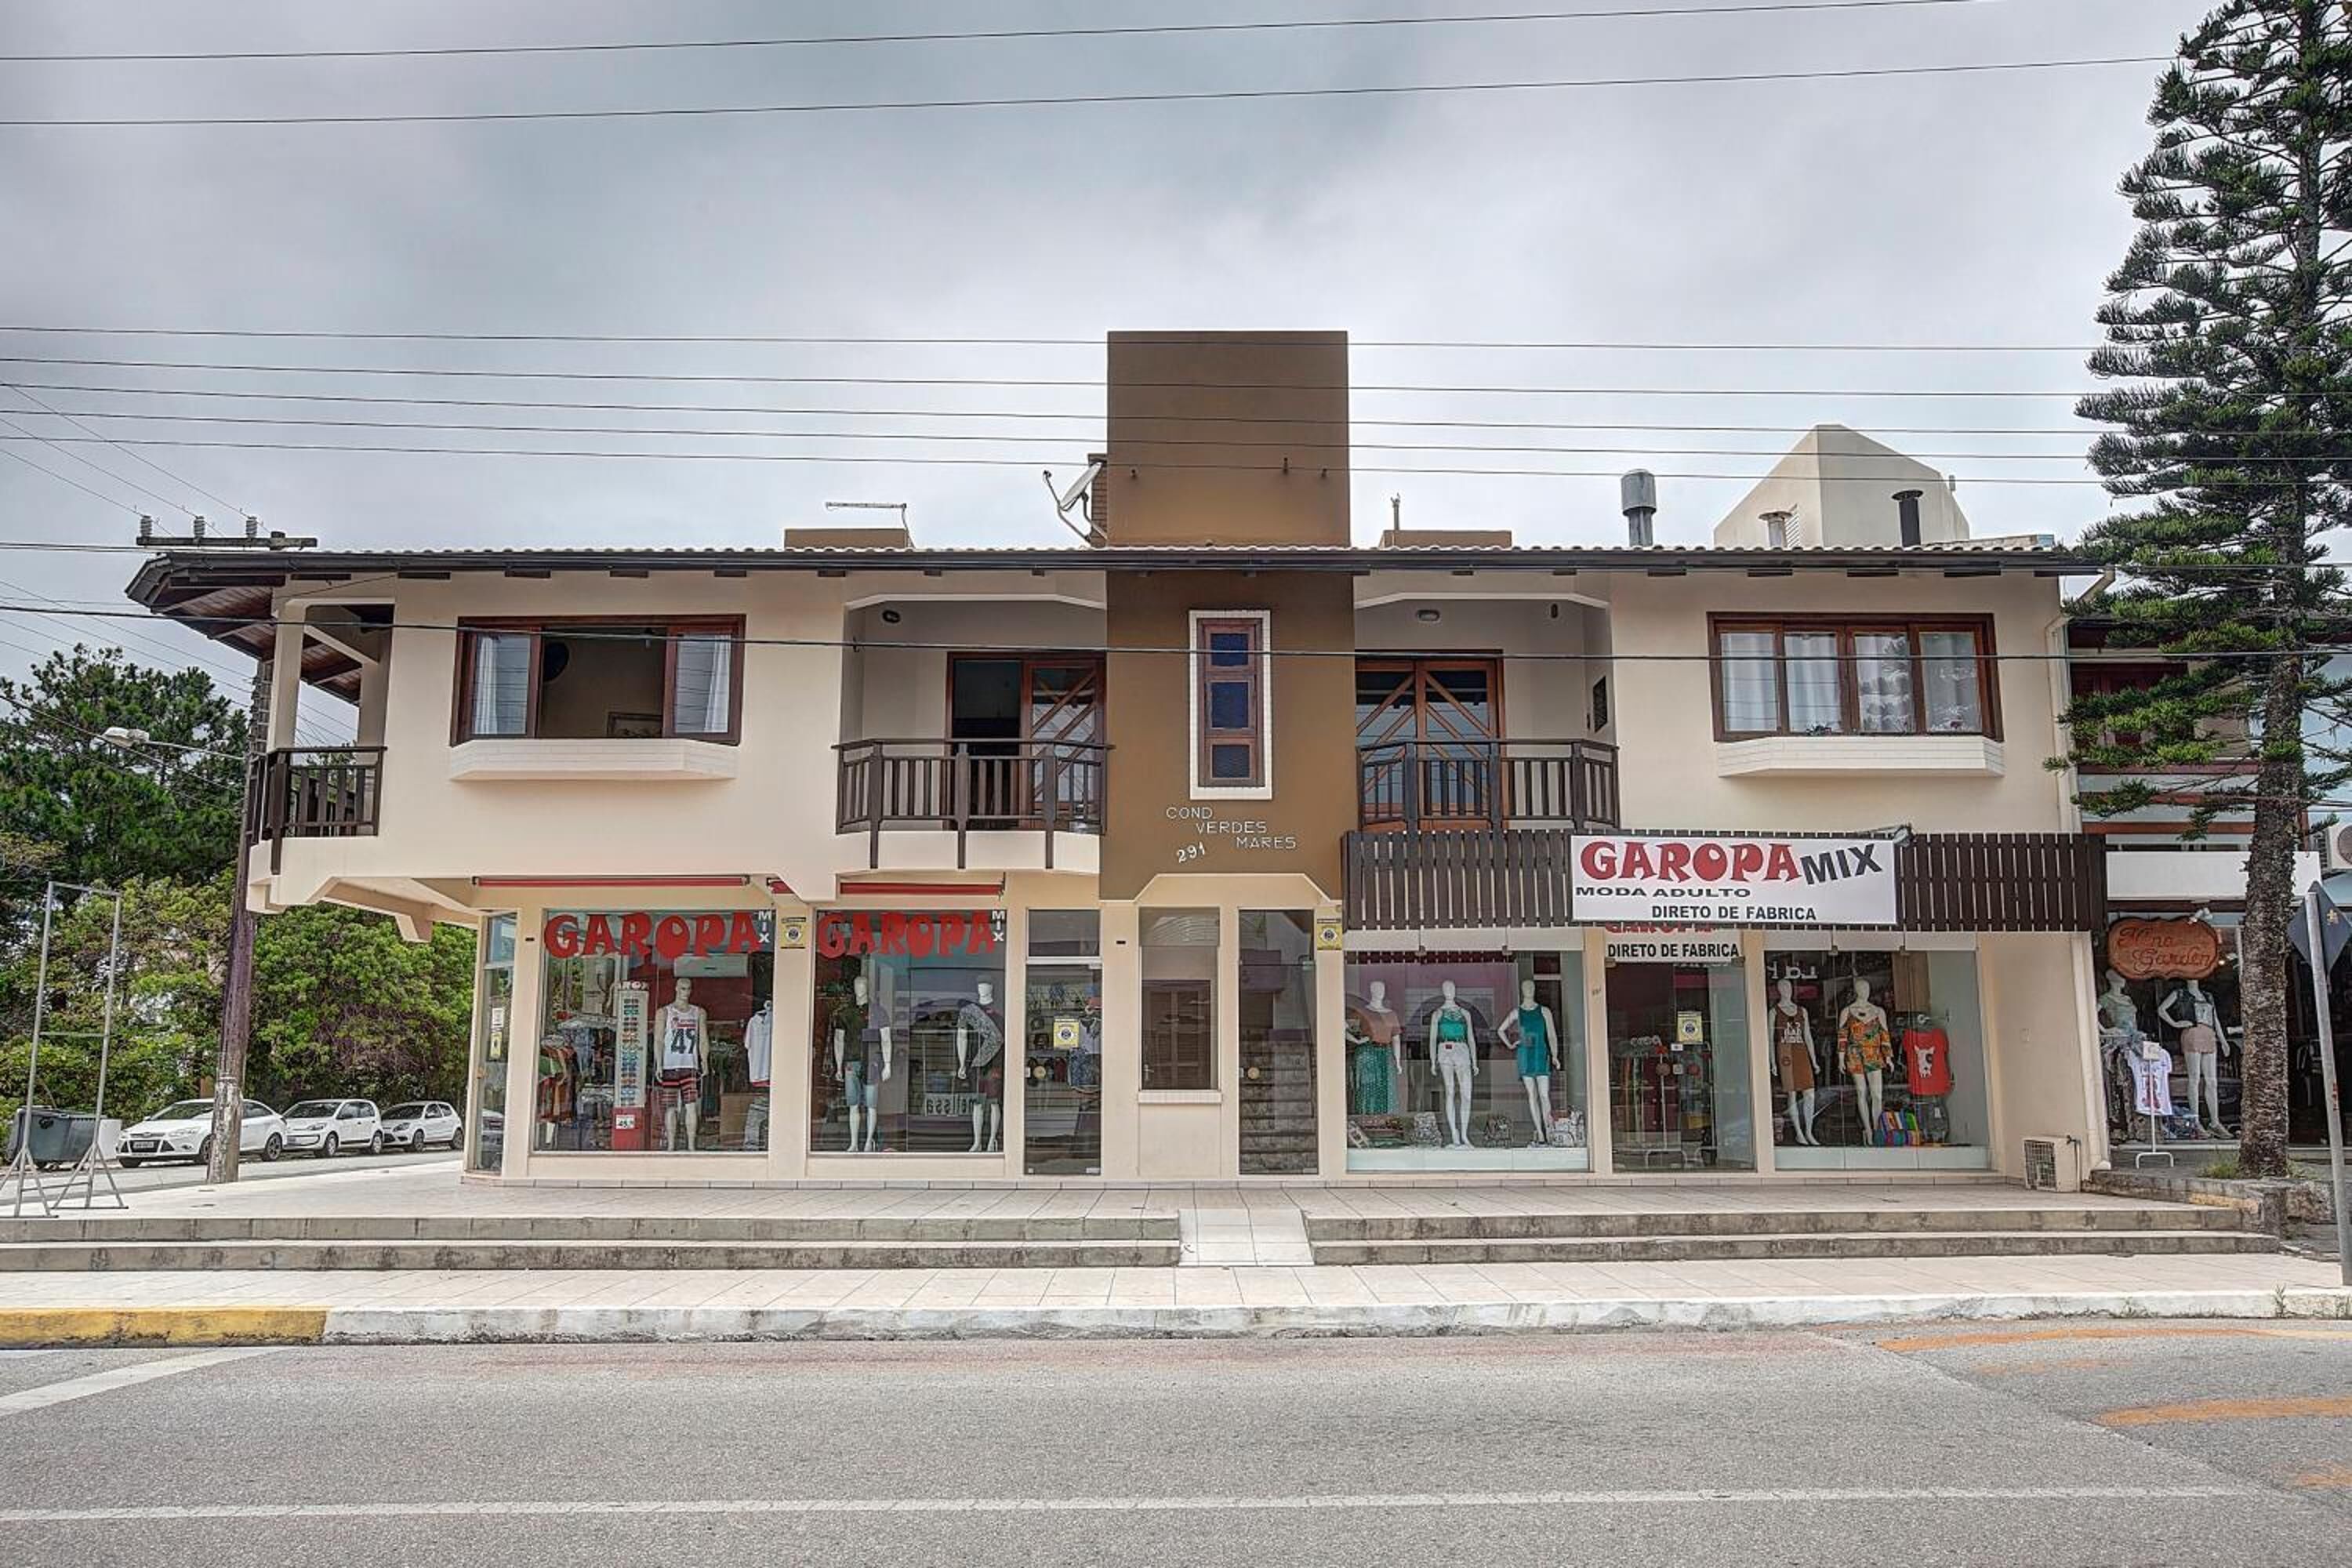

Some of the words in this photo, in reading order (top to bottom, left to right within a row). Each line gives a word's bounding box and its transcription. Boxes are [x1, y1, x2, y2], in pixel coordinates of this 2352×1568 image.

[1166, 807, 1213, 819] COND
[1196, 821, 1268, 834] VERDES
[1177, 840, 1205, 863] 291
[1236, 837, 1296, 849] MARES
[1580, 841, 1802, 883] GAROPA
[1800, 843, 1882, 885] MIX
[1575, 887, 1646, 896] MODA
[1652, 887, 1751, 898] ADULTO
[1651, 905, 1711, 919] DIRETO
[1718, 906, 1740, 920] DE
[1745, 906, 1817, 921] FABRICA
[543, 911, 762, 958] GAROPA
[758, 910, 772, 943] MIX
[817, 909, 996, 958] GAROPA
[991, 910, 1005, 942] MIX
[1608, 943, 1657, 958] DIRETO
[1661, 943, 1679, 957] DE
[1682, 943, 1740, 958] FABRICA
